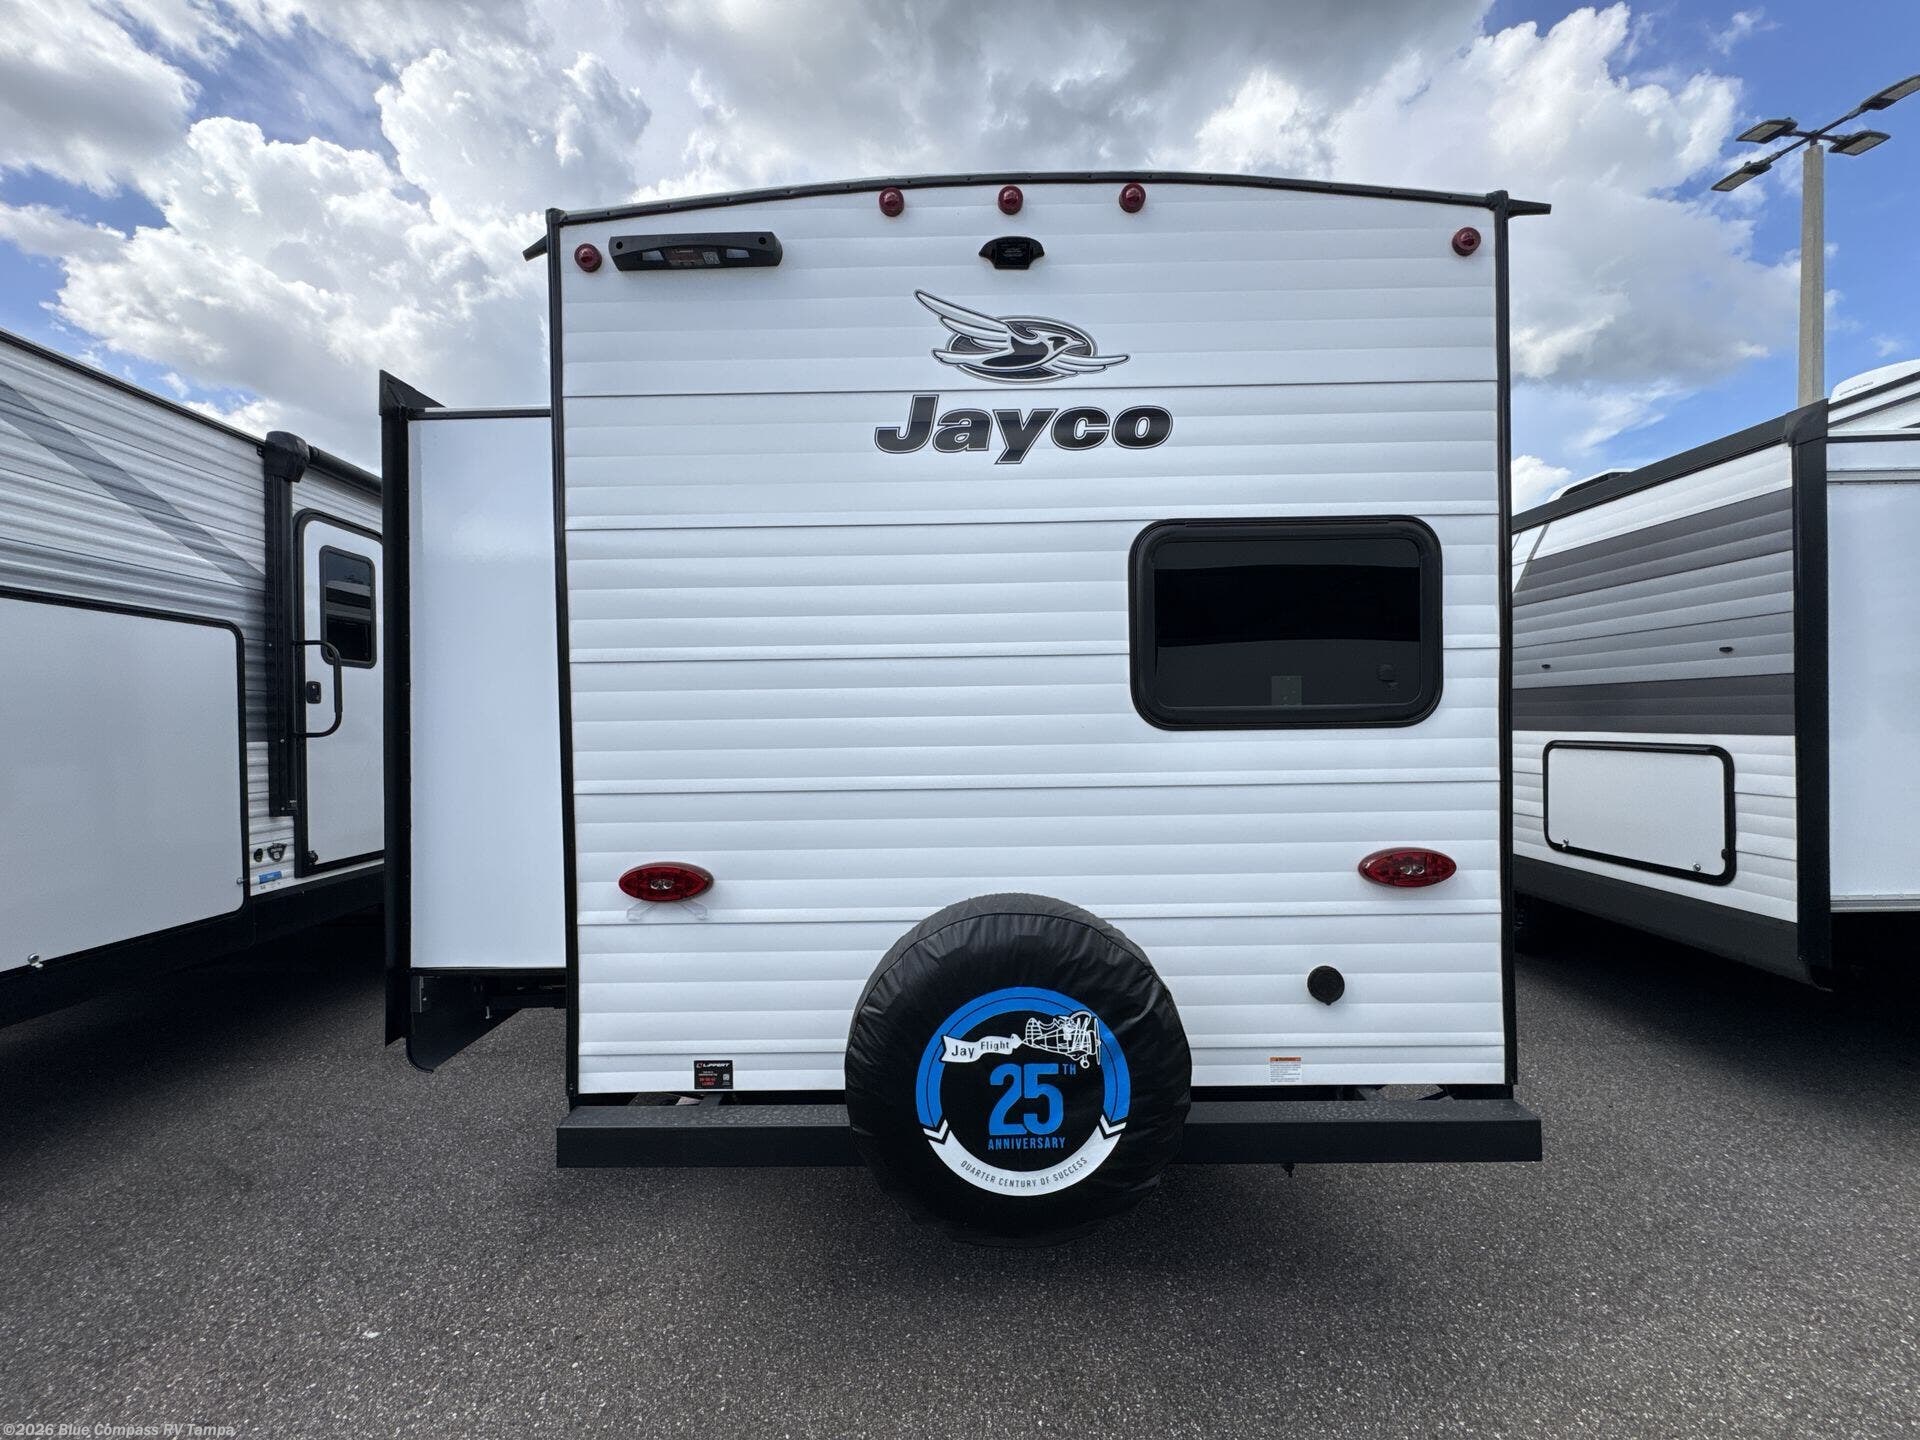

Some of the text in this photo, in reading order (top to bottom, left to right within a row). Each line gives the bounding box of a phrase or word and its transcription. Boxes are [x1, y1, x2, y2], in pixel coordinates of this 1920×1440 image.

[874, 394, 1174, 465] Jayco
[951, 1041, 1010, 1059] Jay Flight
[987, 1137, 1066, 1150] ANNIVERSARY
[960, 1157, 1088, 1188] QUARTER CENTURY OF SUCCESS
